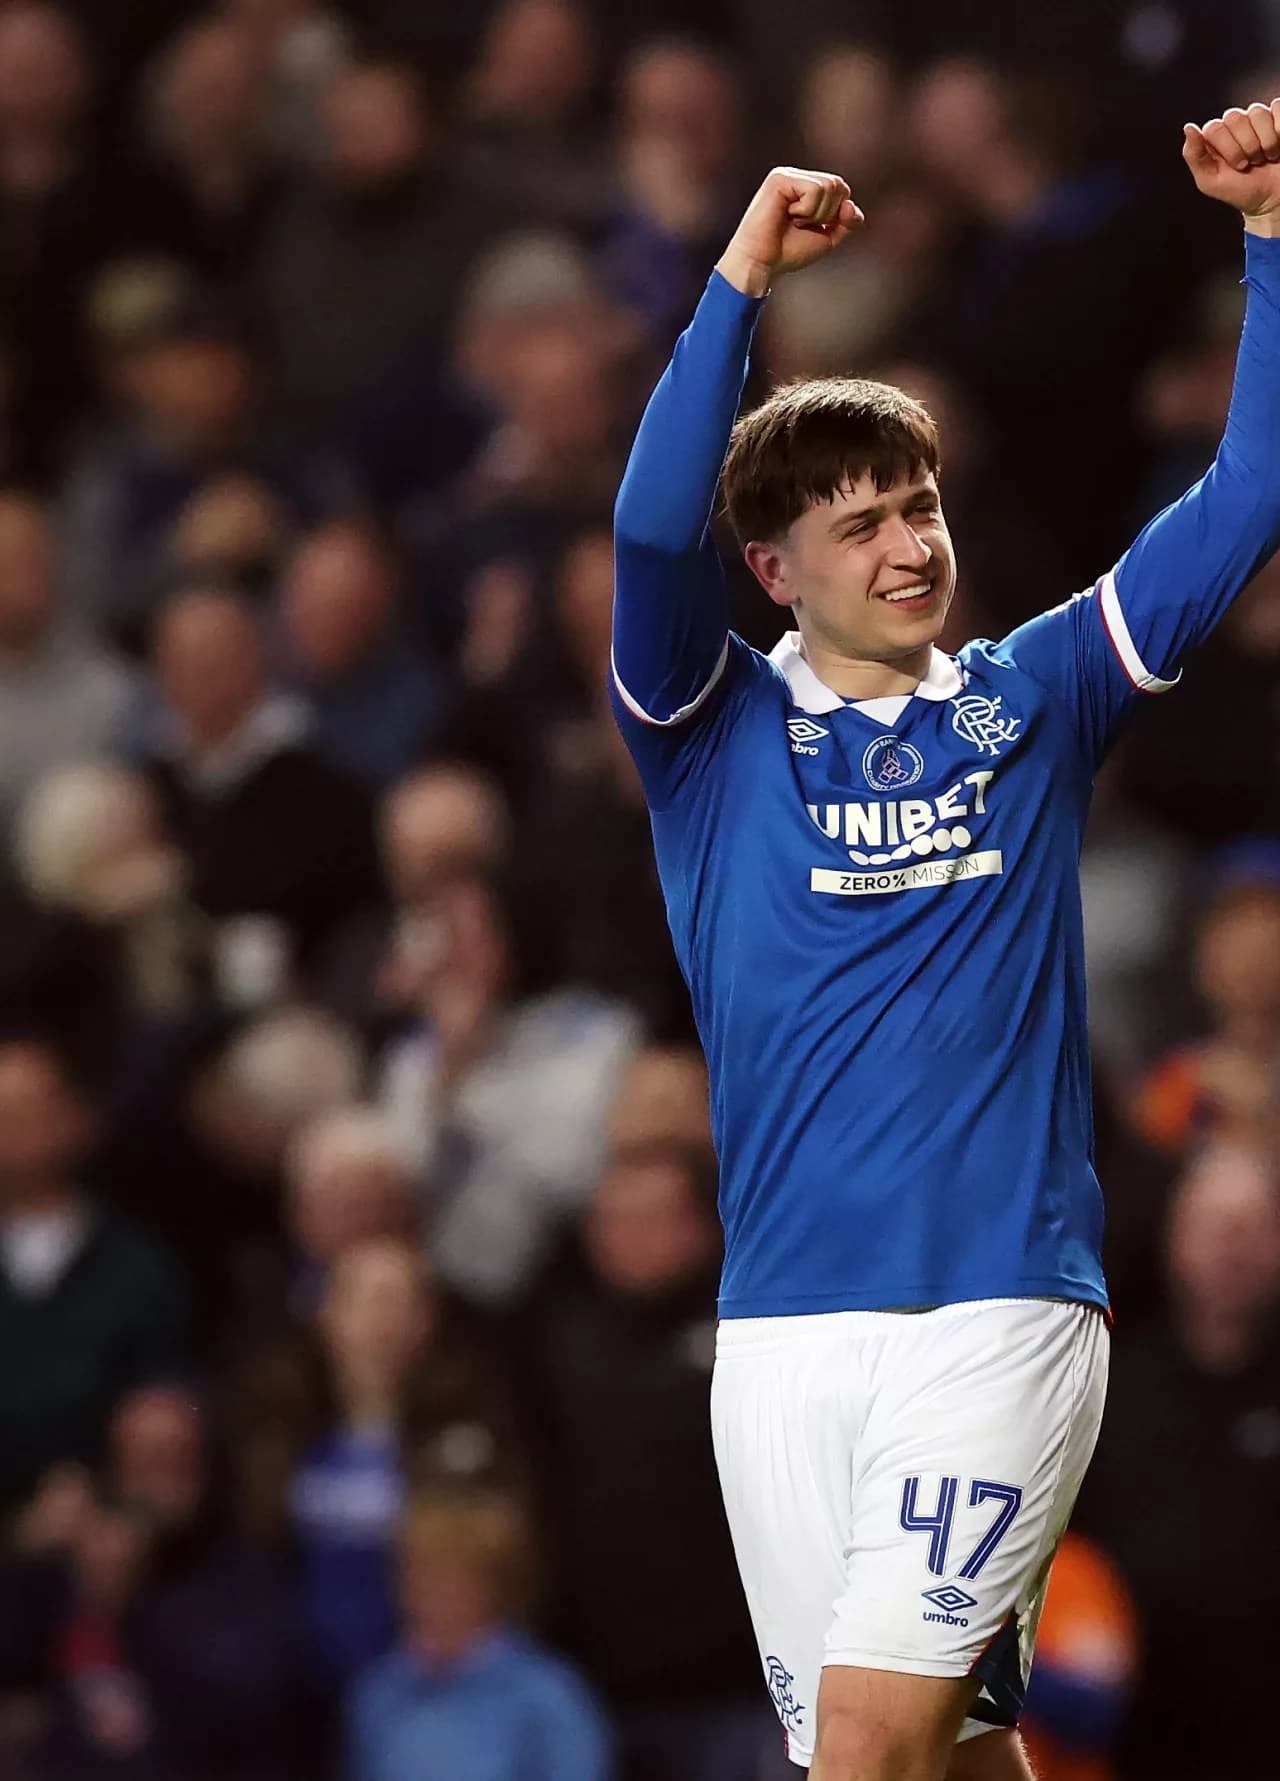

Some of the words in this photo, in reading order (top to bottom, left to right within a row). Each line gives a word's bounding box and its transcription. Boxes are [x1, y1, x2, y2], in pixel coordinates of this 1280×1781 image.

[805, 770, 995, 847] UNIBET
[840, 873, 907, 891] ZERO%
[898, 1474, 1023, 1581] 47
[922, 1611, 969, 1628] umbro
